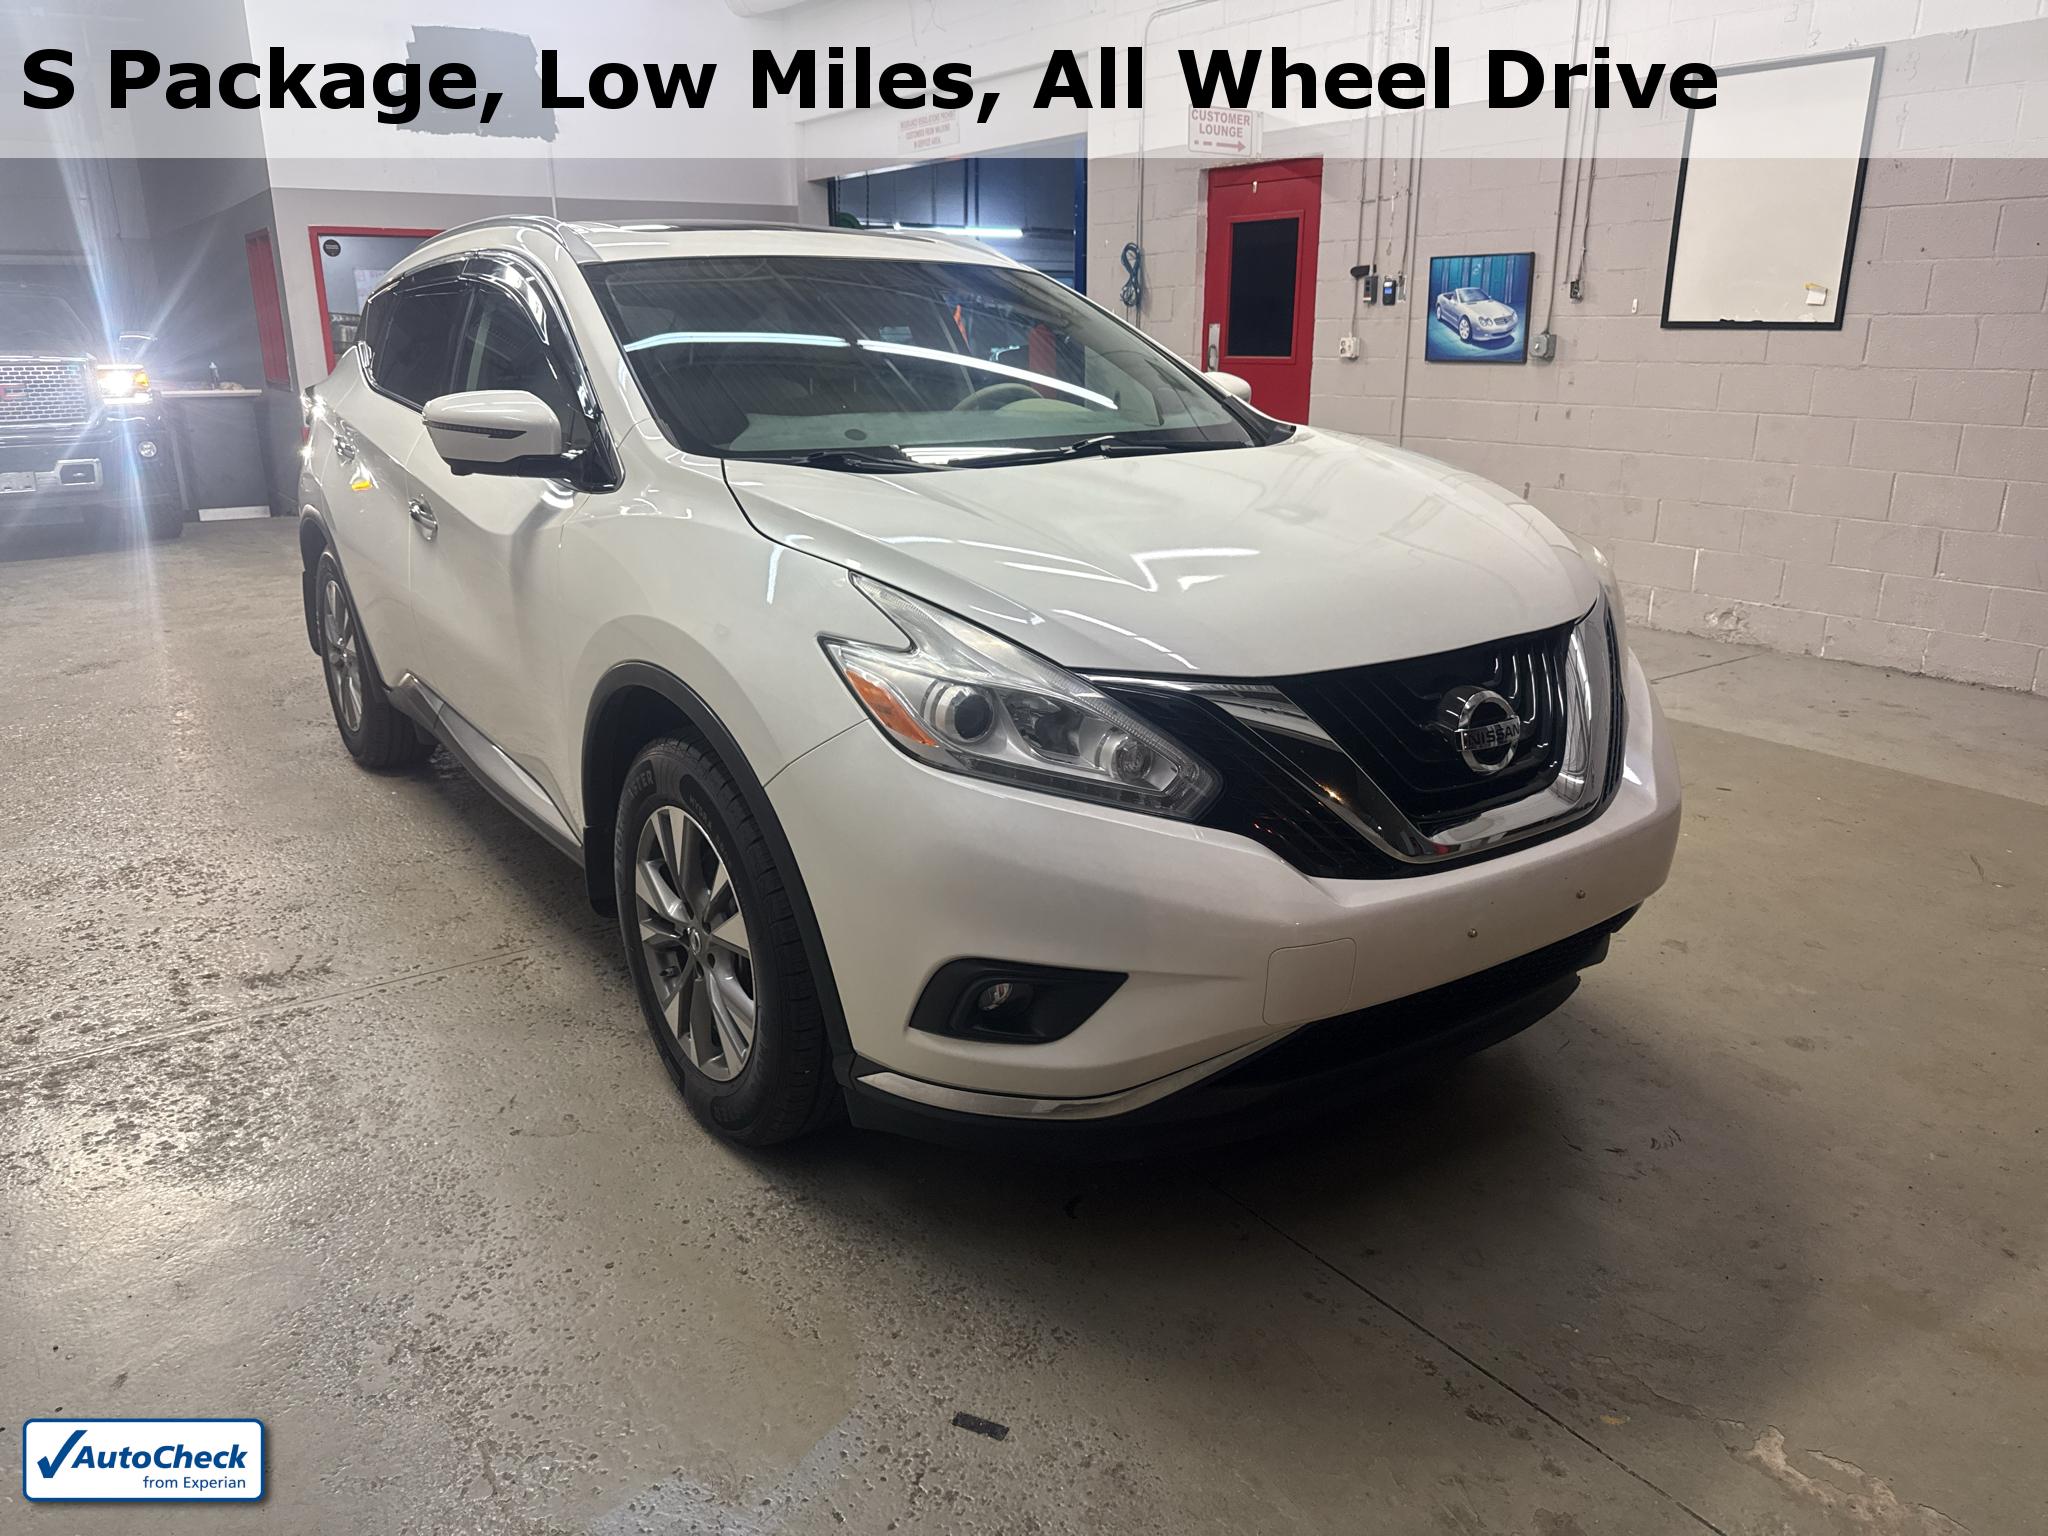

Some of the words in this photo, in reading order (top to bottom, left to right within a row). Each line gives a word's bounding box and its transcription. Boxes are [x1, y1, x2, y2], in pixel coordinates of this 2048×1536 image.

[1191, 109, 1250, 126] CUSTOMER
[1199, 123, 1243, 138] LOUNGE
[1468, 722, 1519, 746] NISSAN
